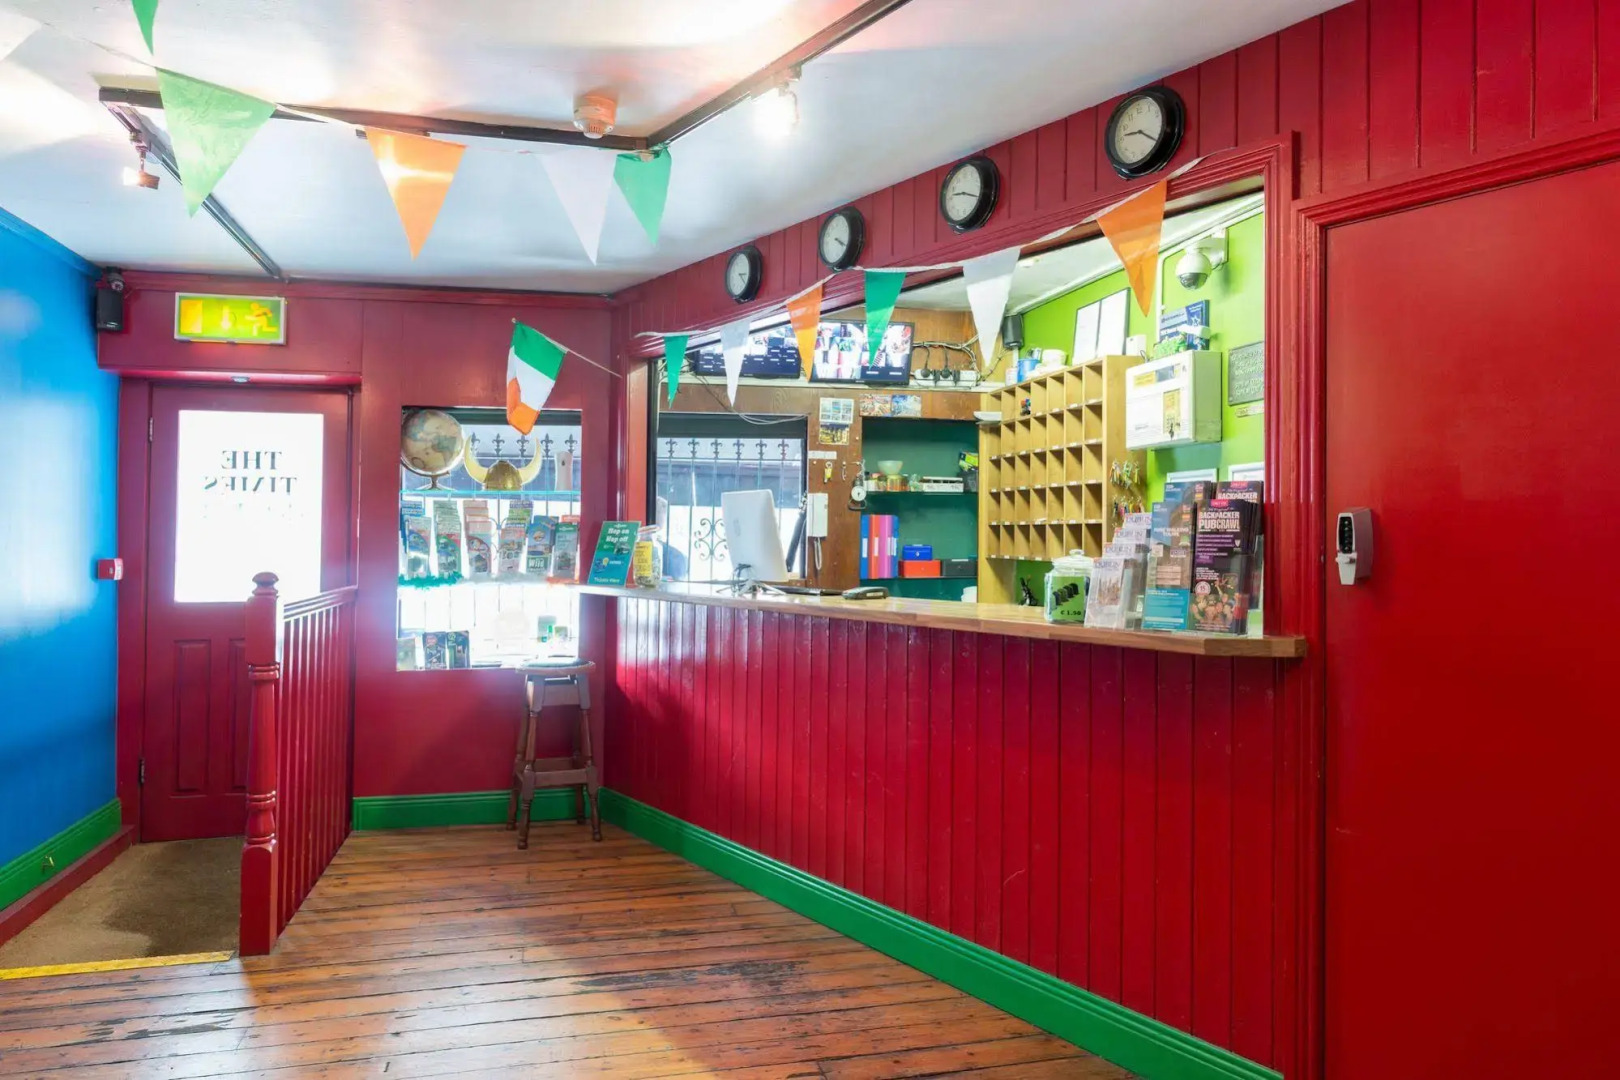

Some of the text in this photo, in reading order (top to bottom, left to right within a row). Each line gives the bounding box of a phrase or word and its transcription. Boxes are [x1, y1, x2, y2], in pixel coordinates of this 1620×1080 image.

[1217, 491, 1258, 500] BACKPACKER
[1199, 511, 1240, 519] BACKPACKER
[1199, 519, 1240, 529] PUBCRAWL
